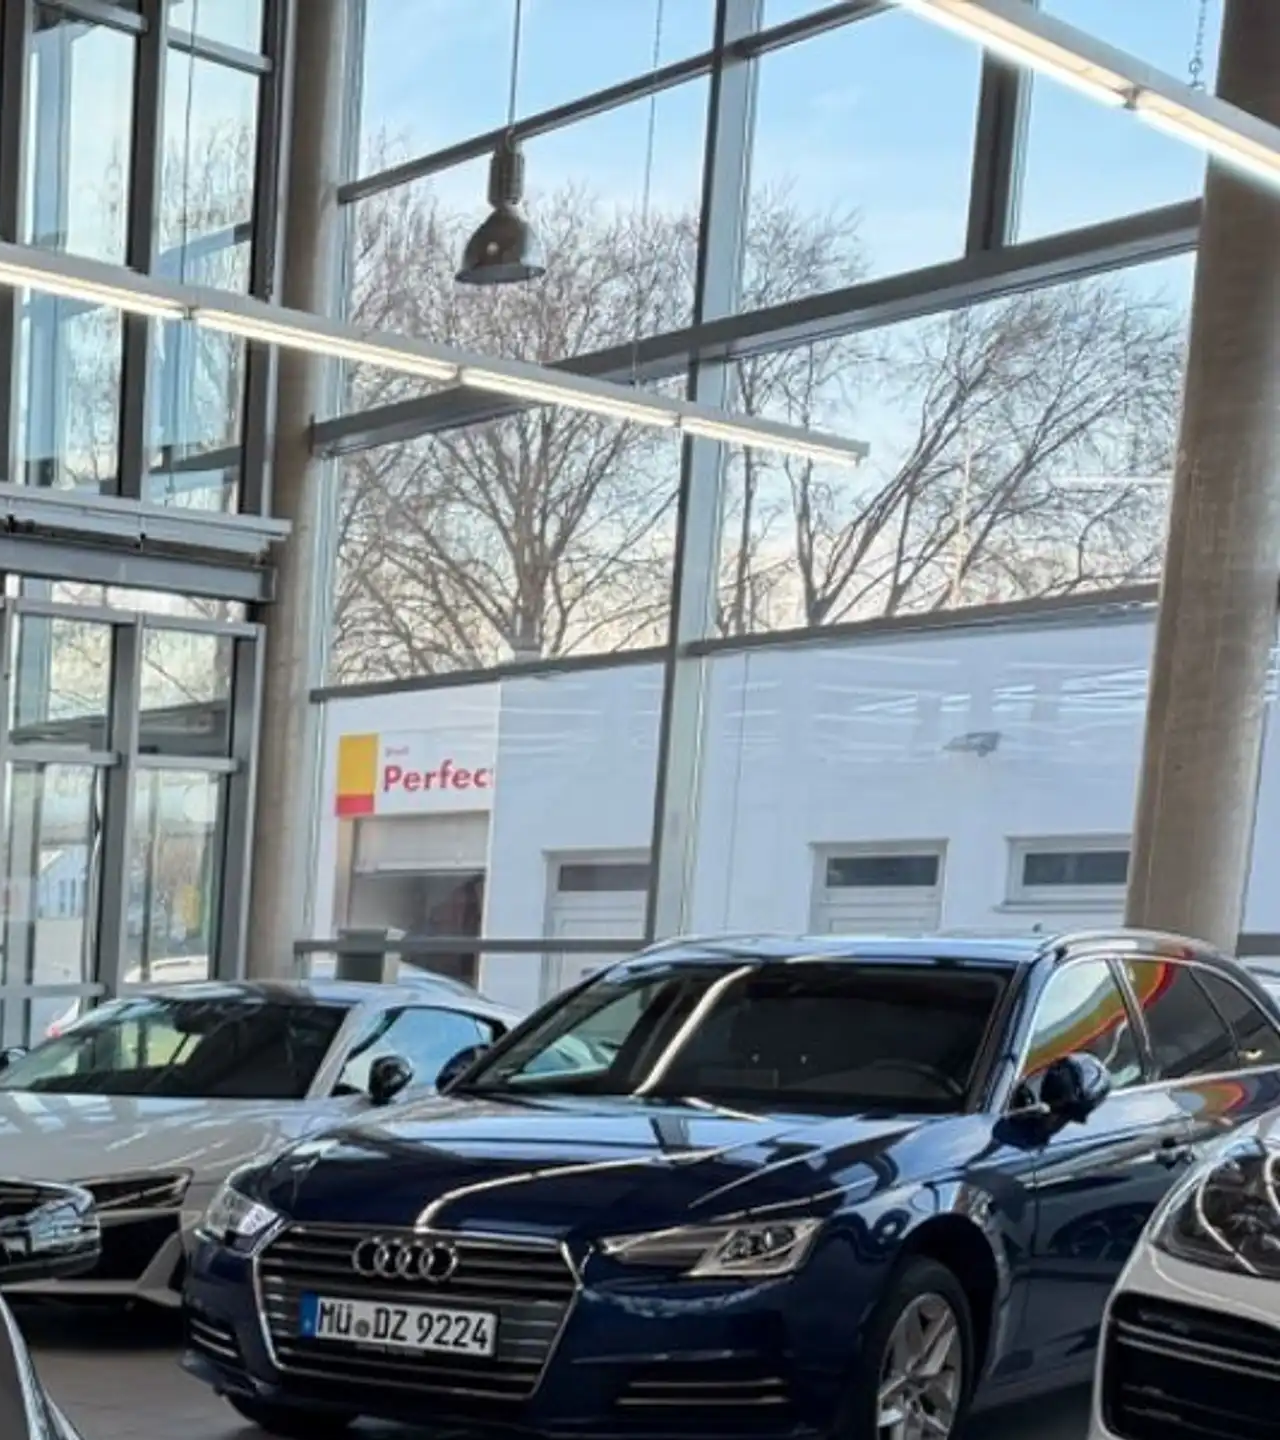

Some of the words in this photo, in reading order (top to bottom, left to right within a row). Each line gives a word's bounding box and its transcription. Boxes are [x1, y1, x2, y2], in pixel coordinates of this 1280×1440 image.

[383, 758, 493, 793] Perfec
[317, 1302, 353, 1336] MÜ
[371, 1306, 408, 1342] DZ
[415, 1312, 489, 1350] 9224
